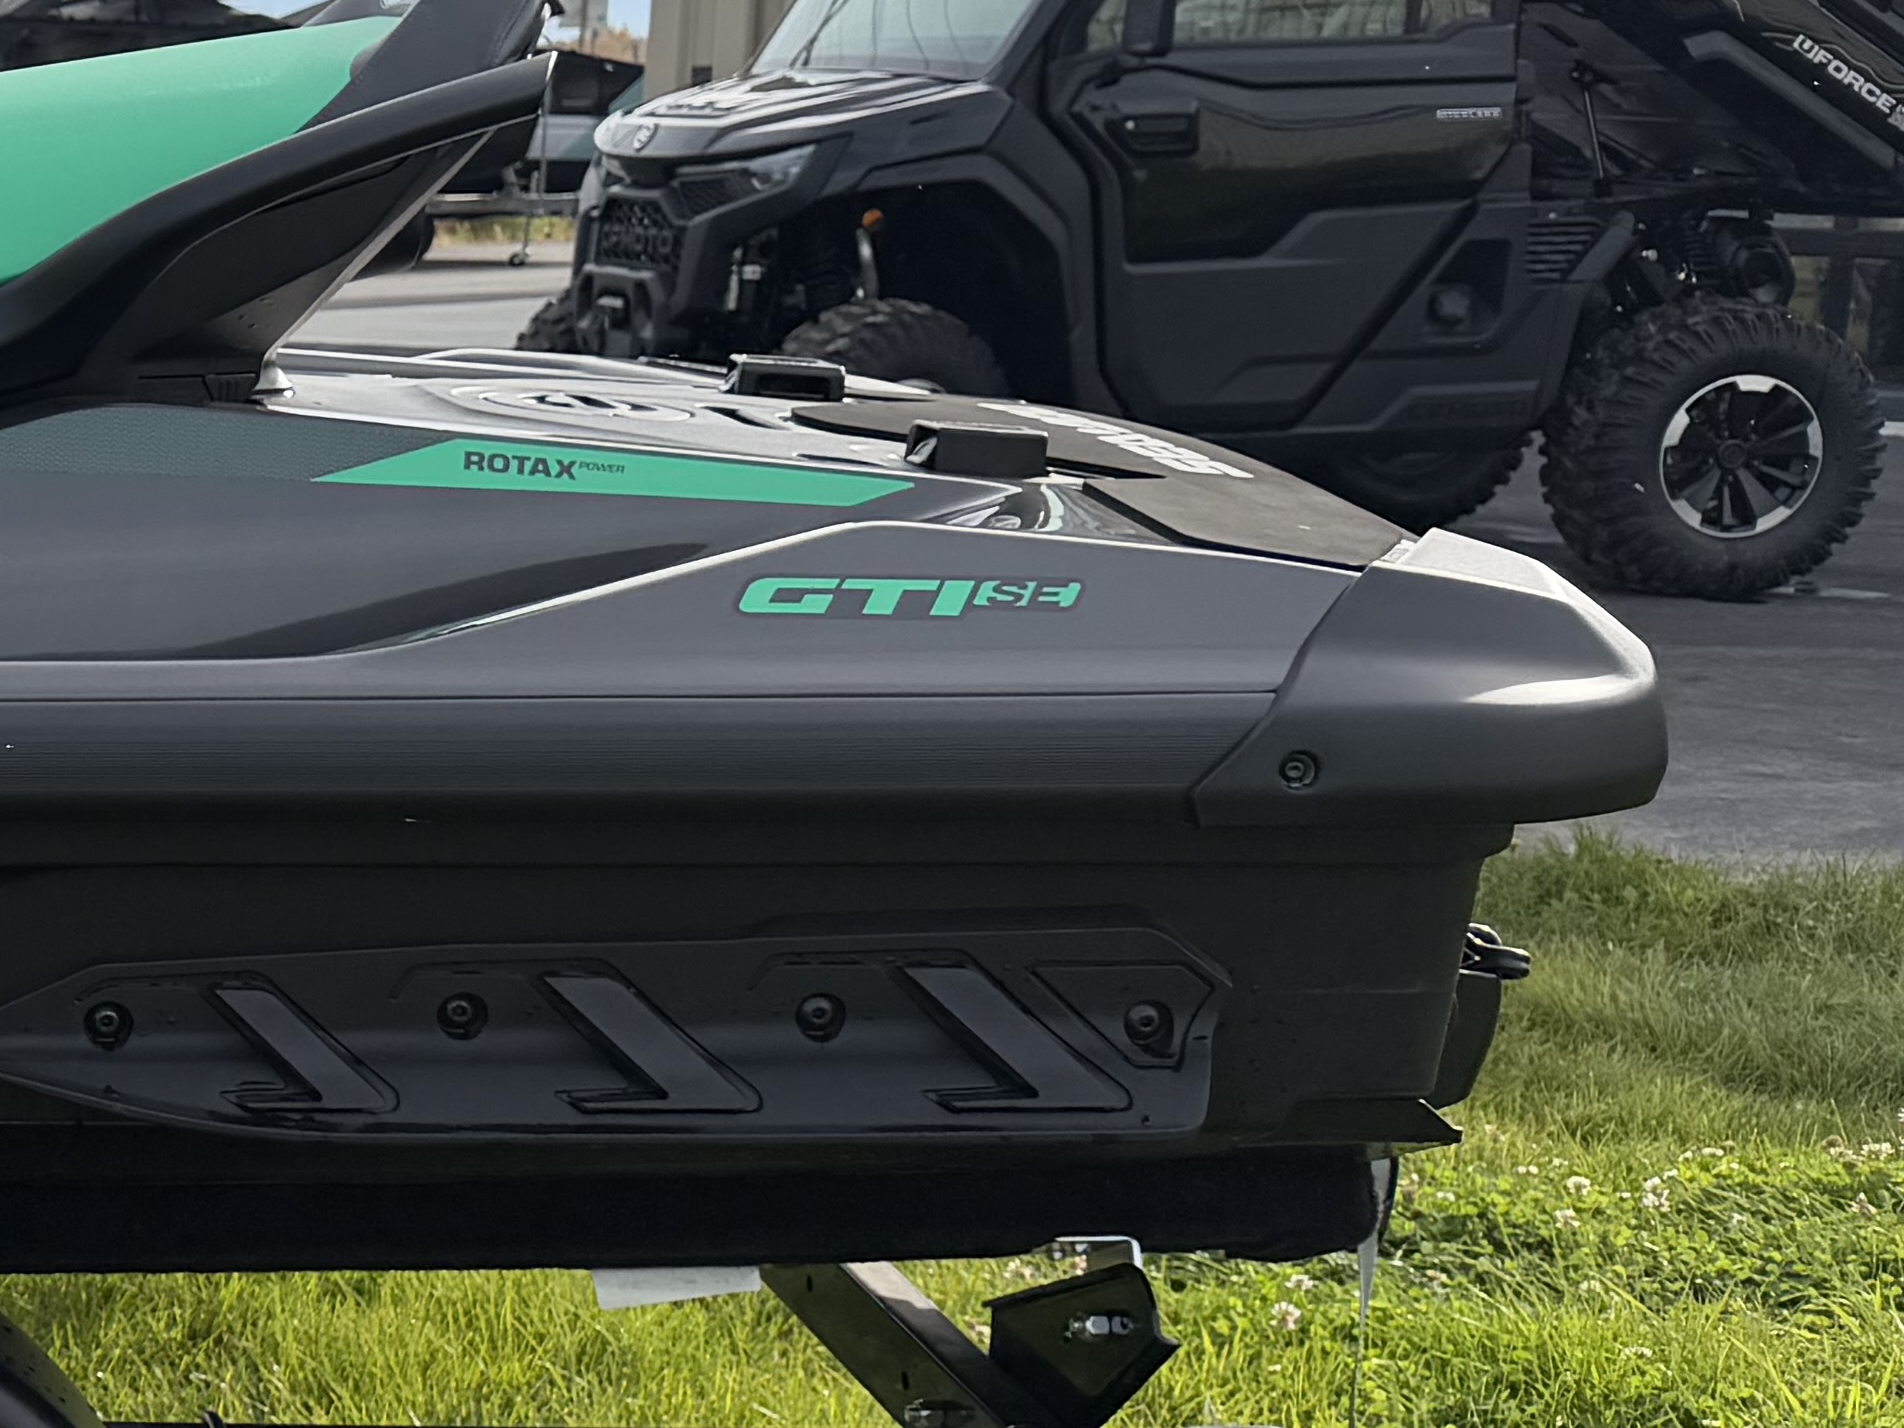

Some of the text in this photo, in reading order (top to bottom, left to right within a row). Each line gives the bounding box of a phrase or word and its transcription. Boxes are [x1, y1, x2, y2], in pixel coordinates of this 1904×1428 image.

[463, 450, 626, 481] ROTAX POWER
[739, 577, 975, 616] GTI
